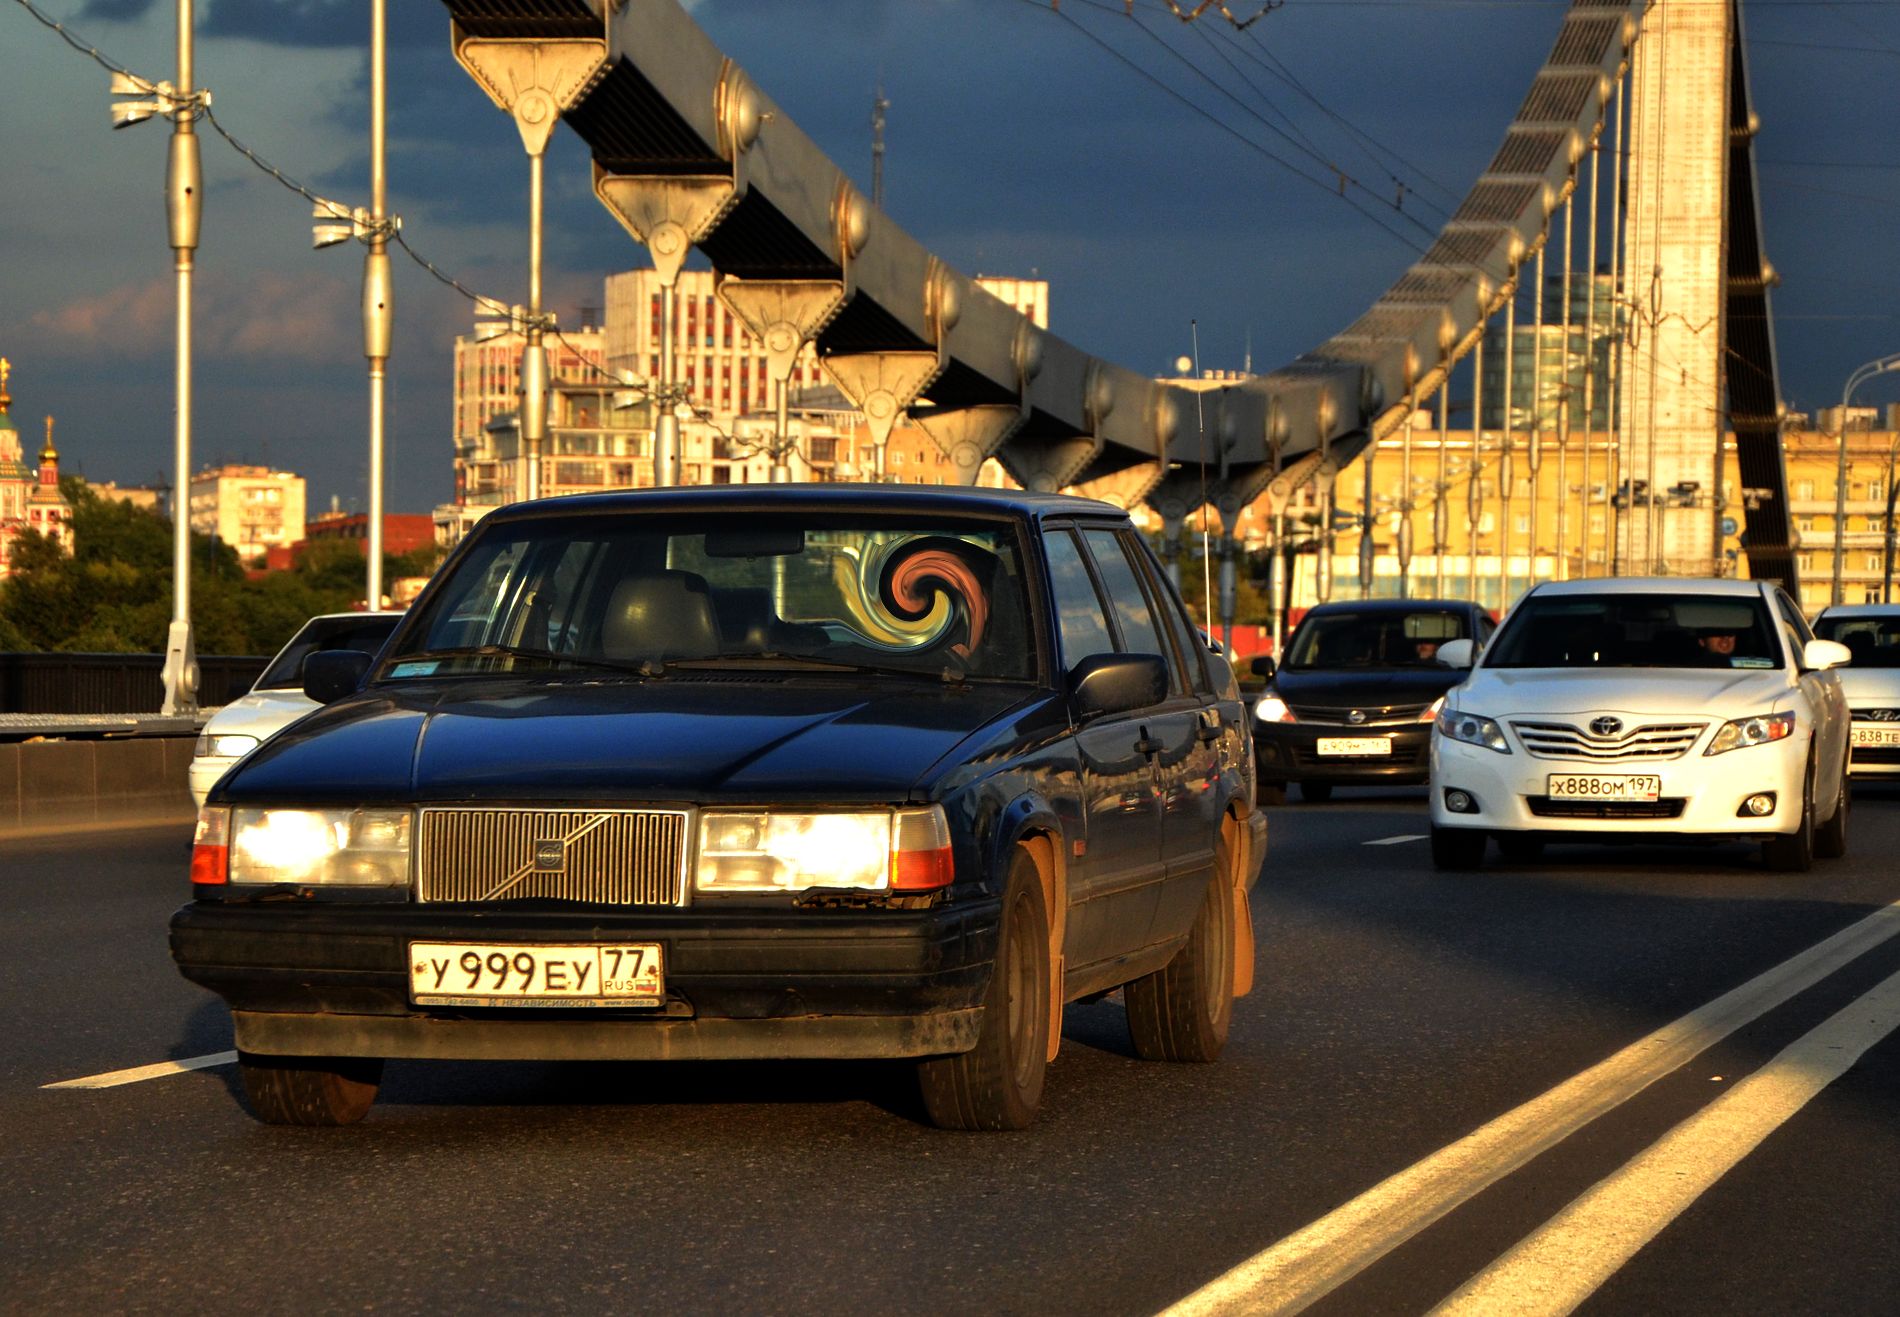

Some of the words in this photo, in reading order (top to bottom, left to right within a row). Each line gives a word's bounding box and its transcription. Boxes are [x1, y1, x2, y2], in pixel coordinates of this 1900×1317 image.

[1629, 778, 1653, 790] 197
[605, 950, 644, 979] 77
[604, 980, 634, 991] RUS
